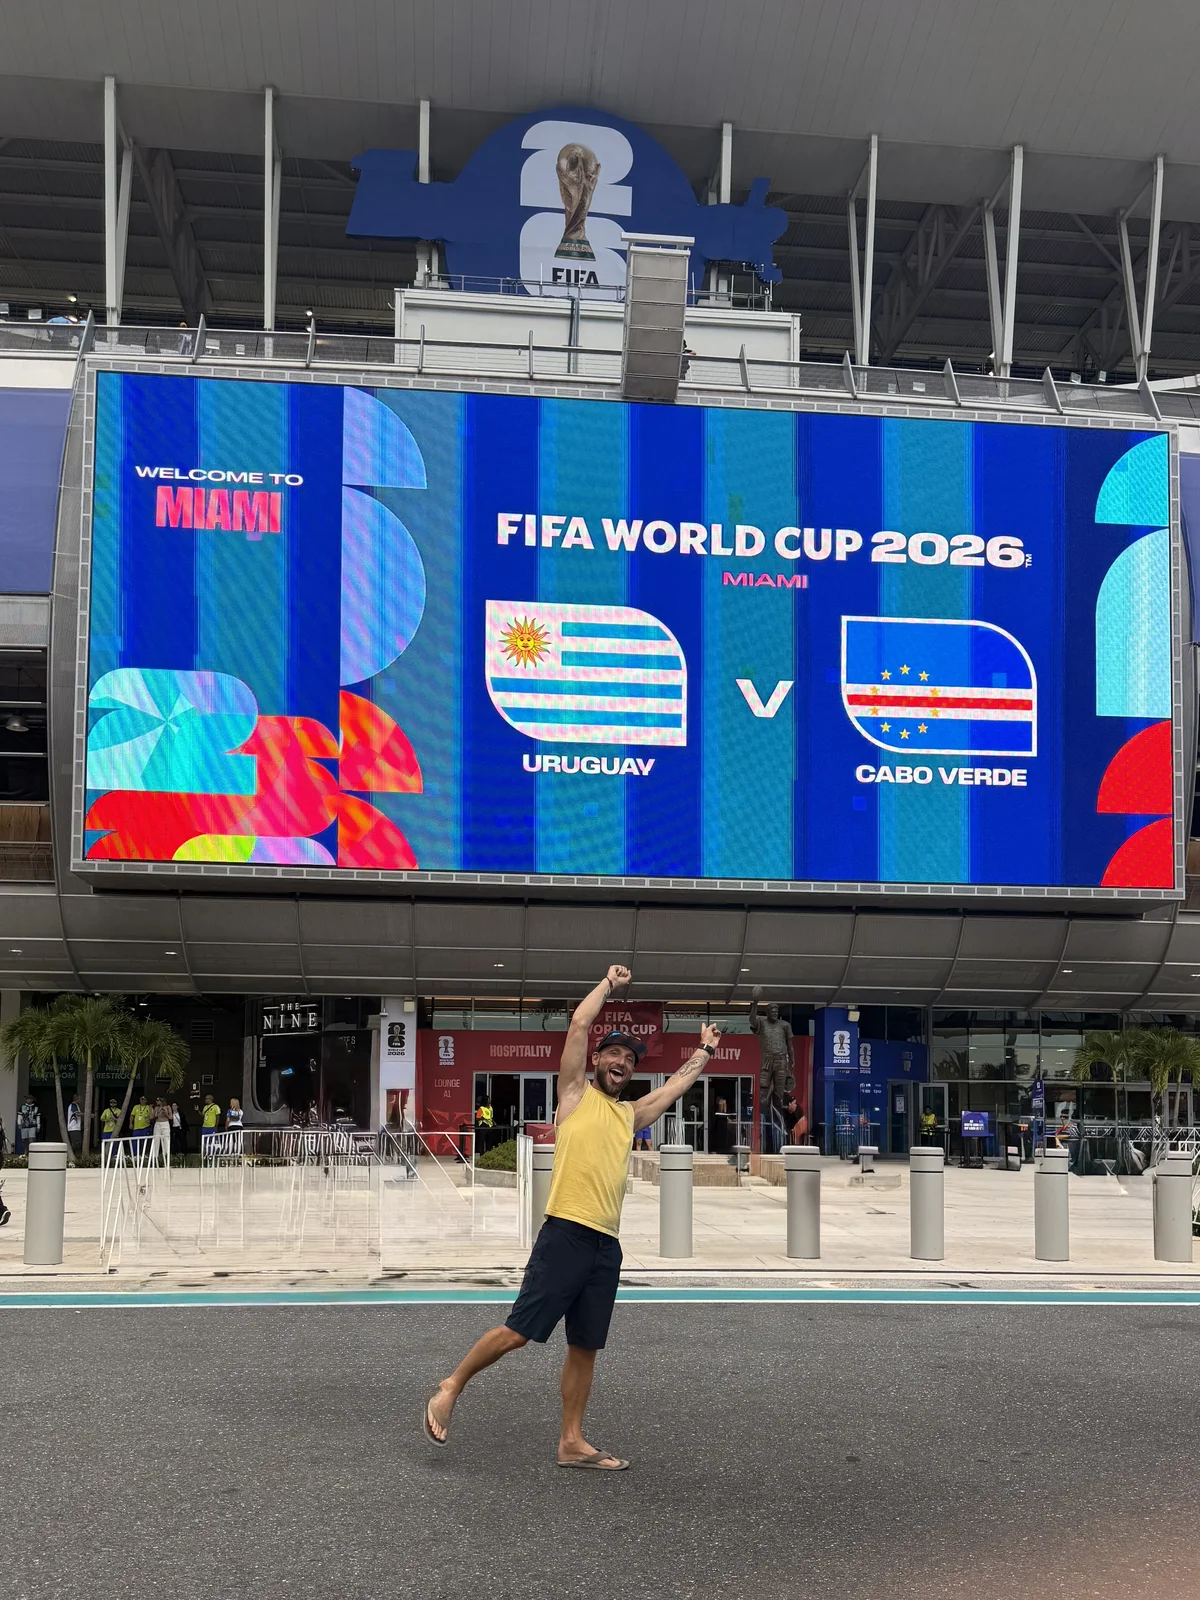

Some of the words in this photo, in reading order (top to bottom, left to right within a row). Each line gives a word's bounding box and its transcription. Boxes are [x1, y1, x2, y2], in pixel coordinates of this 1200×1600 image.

[552, 267, 600, 286] FIFA
[135, 465, 264, 484] WELCOME
[268, 473, 304, 487] TO
[155, 485, 283, 534] MIAMI
[497, 512, 595, 550] FIFA
[601, 518, 766, 557] WORLD
[774, 526, 863, 561] CUP
[870, 530, 1025, 568] 2026
[722, 571, 809, 589] MIAMI
[735, 678, 794, 719] V
[522, 754, 656, 777] URUGUAY
[855, 764, 933, 785] CABO
[938, 767, 1028, 787] VERDE
[280, 1002, 300, 1011] THE
[263, 1013, 318, 1030] NINE
[605, 1012, 634, 1022] FIFA
[631, 1024, 657, 1035] CUP
[489, 1045, 551, 1057] HOSPITALITY
[434, 1079, 461, 1088] LOUNGE
[443, 1090, 452, 1098] A1
